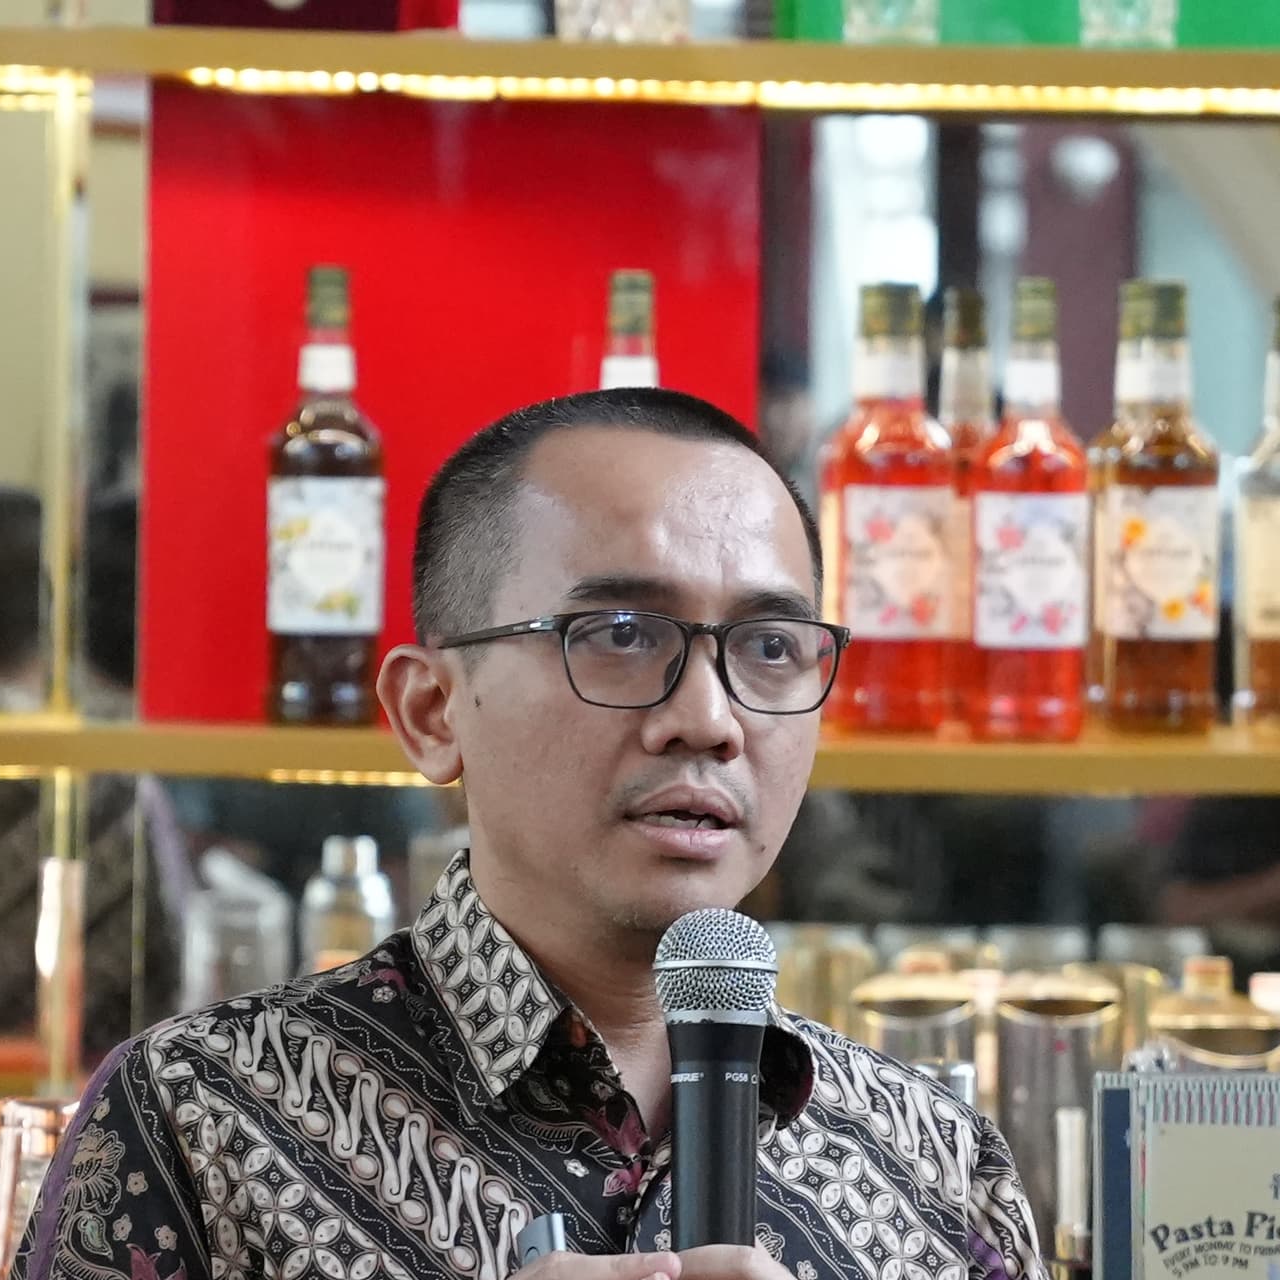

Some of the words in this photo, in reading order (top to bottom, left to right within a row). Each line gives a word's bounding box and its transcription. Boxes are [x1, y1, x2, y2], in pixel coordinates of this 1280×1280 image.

[724, 1071, 749, 1082] PG58
[1149, 1214, 1235, 1254] Pasta
[1163, 1246, 1191, 1270] EVERY
[1193, 1241, 1235, 1255] MONDAY
[1239, 1243, 1253, 1255] TO
[1183, 1258, 1200, 1272] PM
[1203, 1254, 1218, 1266] TO
[1221, 1255, 1229, 1266] 9
[1232, 1257, 1249, 1270] PM
